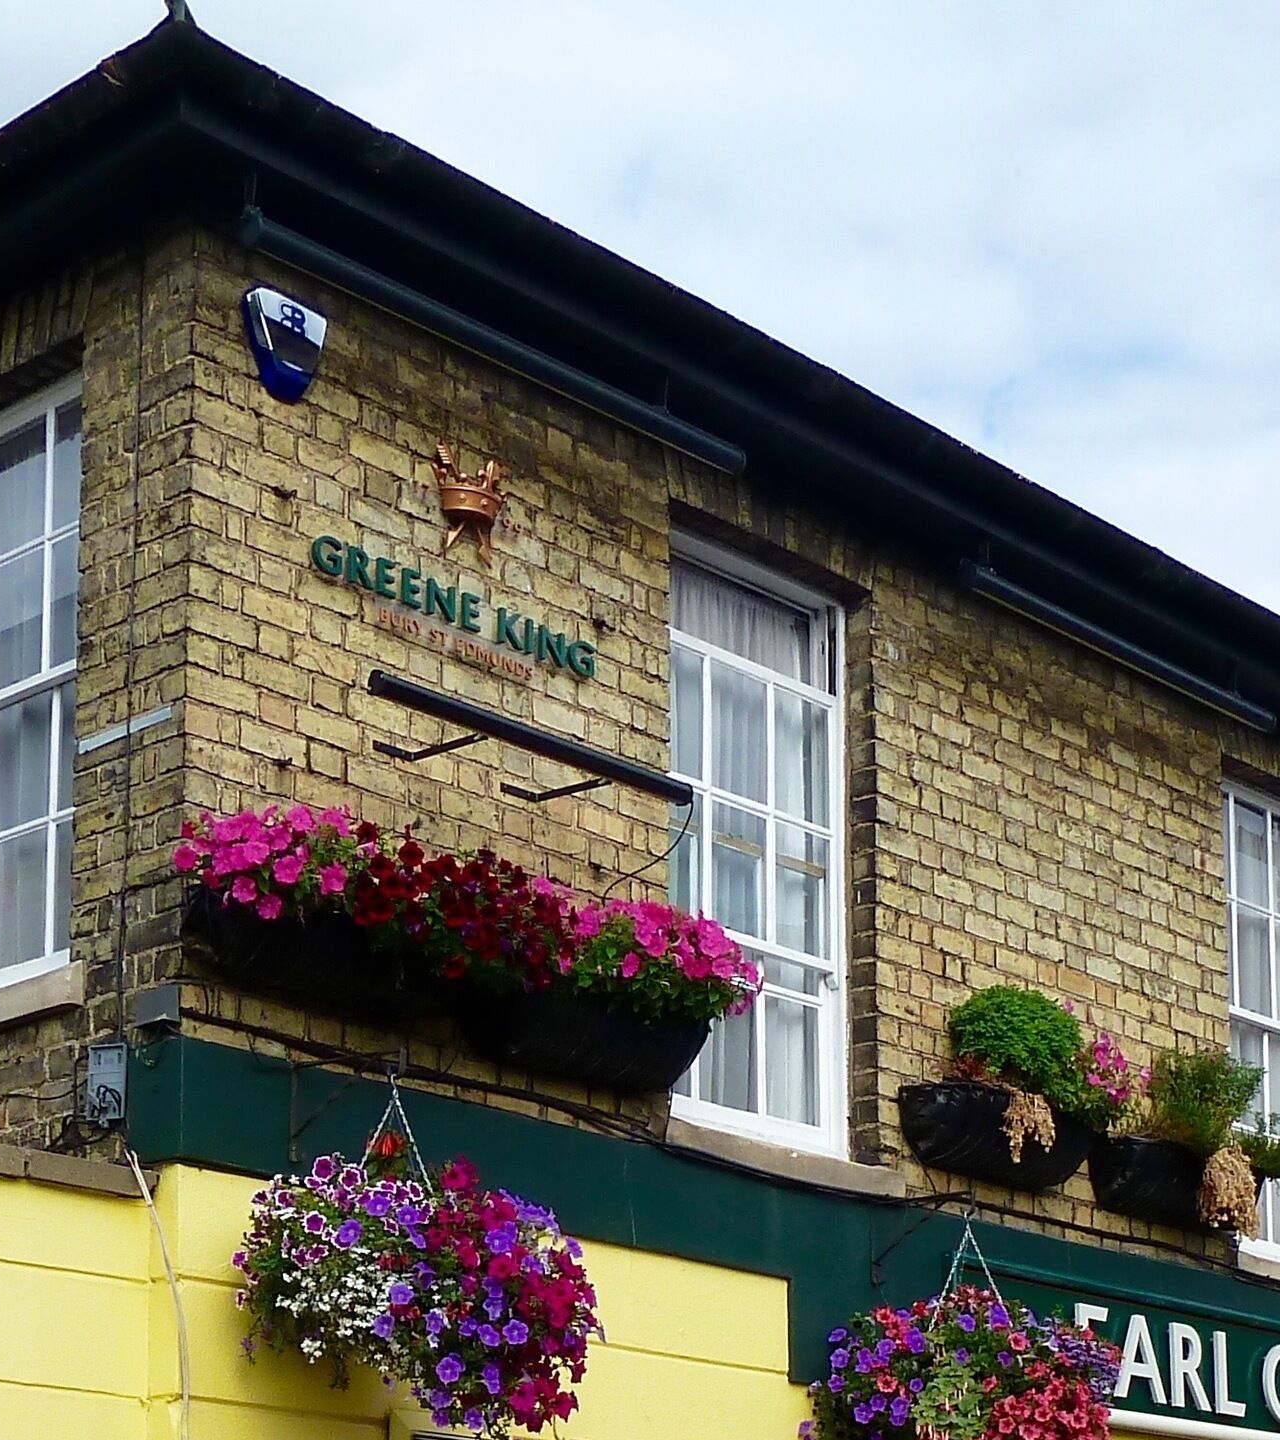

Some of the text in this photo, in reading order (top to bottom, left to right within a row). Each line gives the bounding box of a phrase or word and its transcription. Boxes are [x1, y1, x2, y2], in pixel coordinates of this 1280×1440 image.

[312, 534, 597, 679] GREENE KING
[379, 608, 534, 681] BURY ST EDMUNDS
